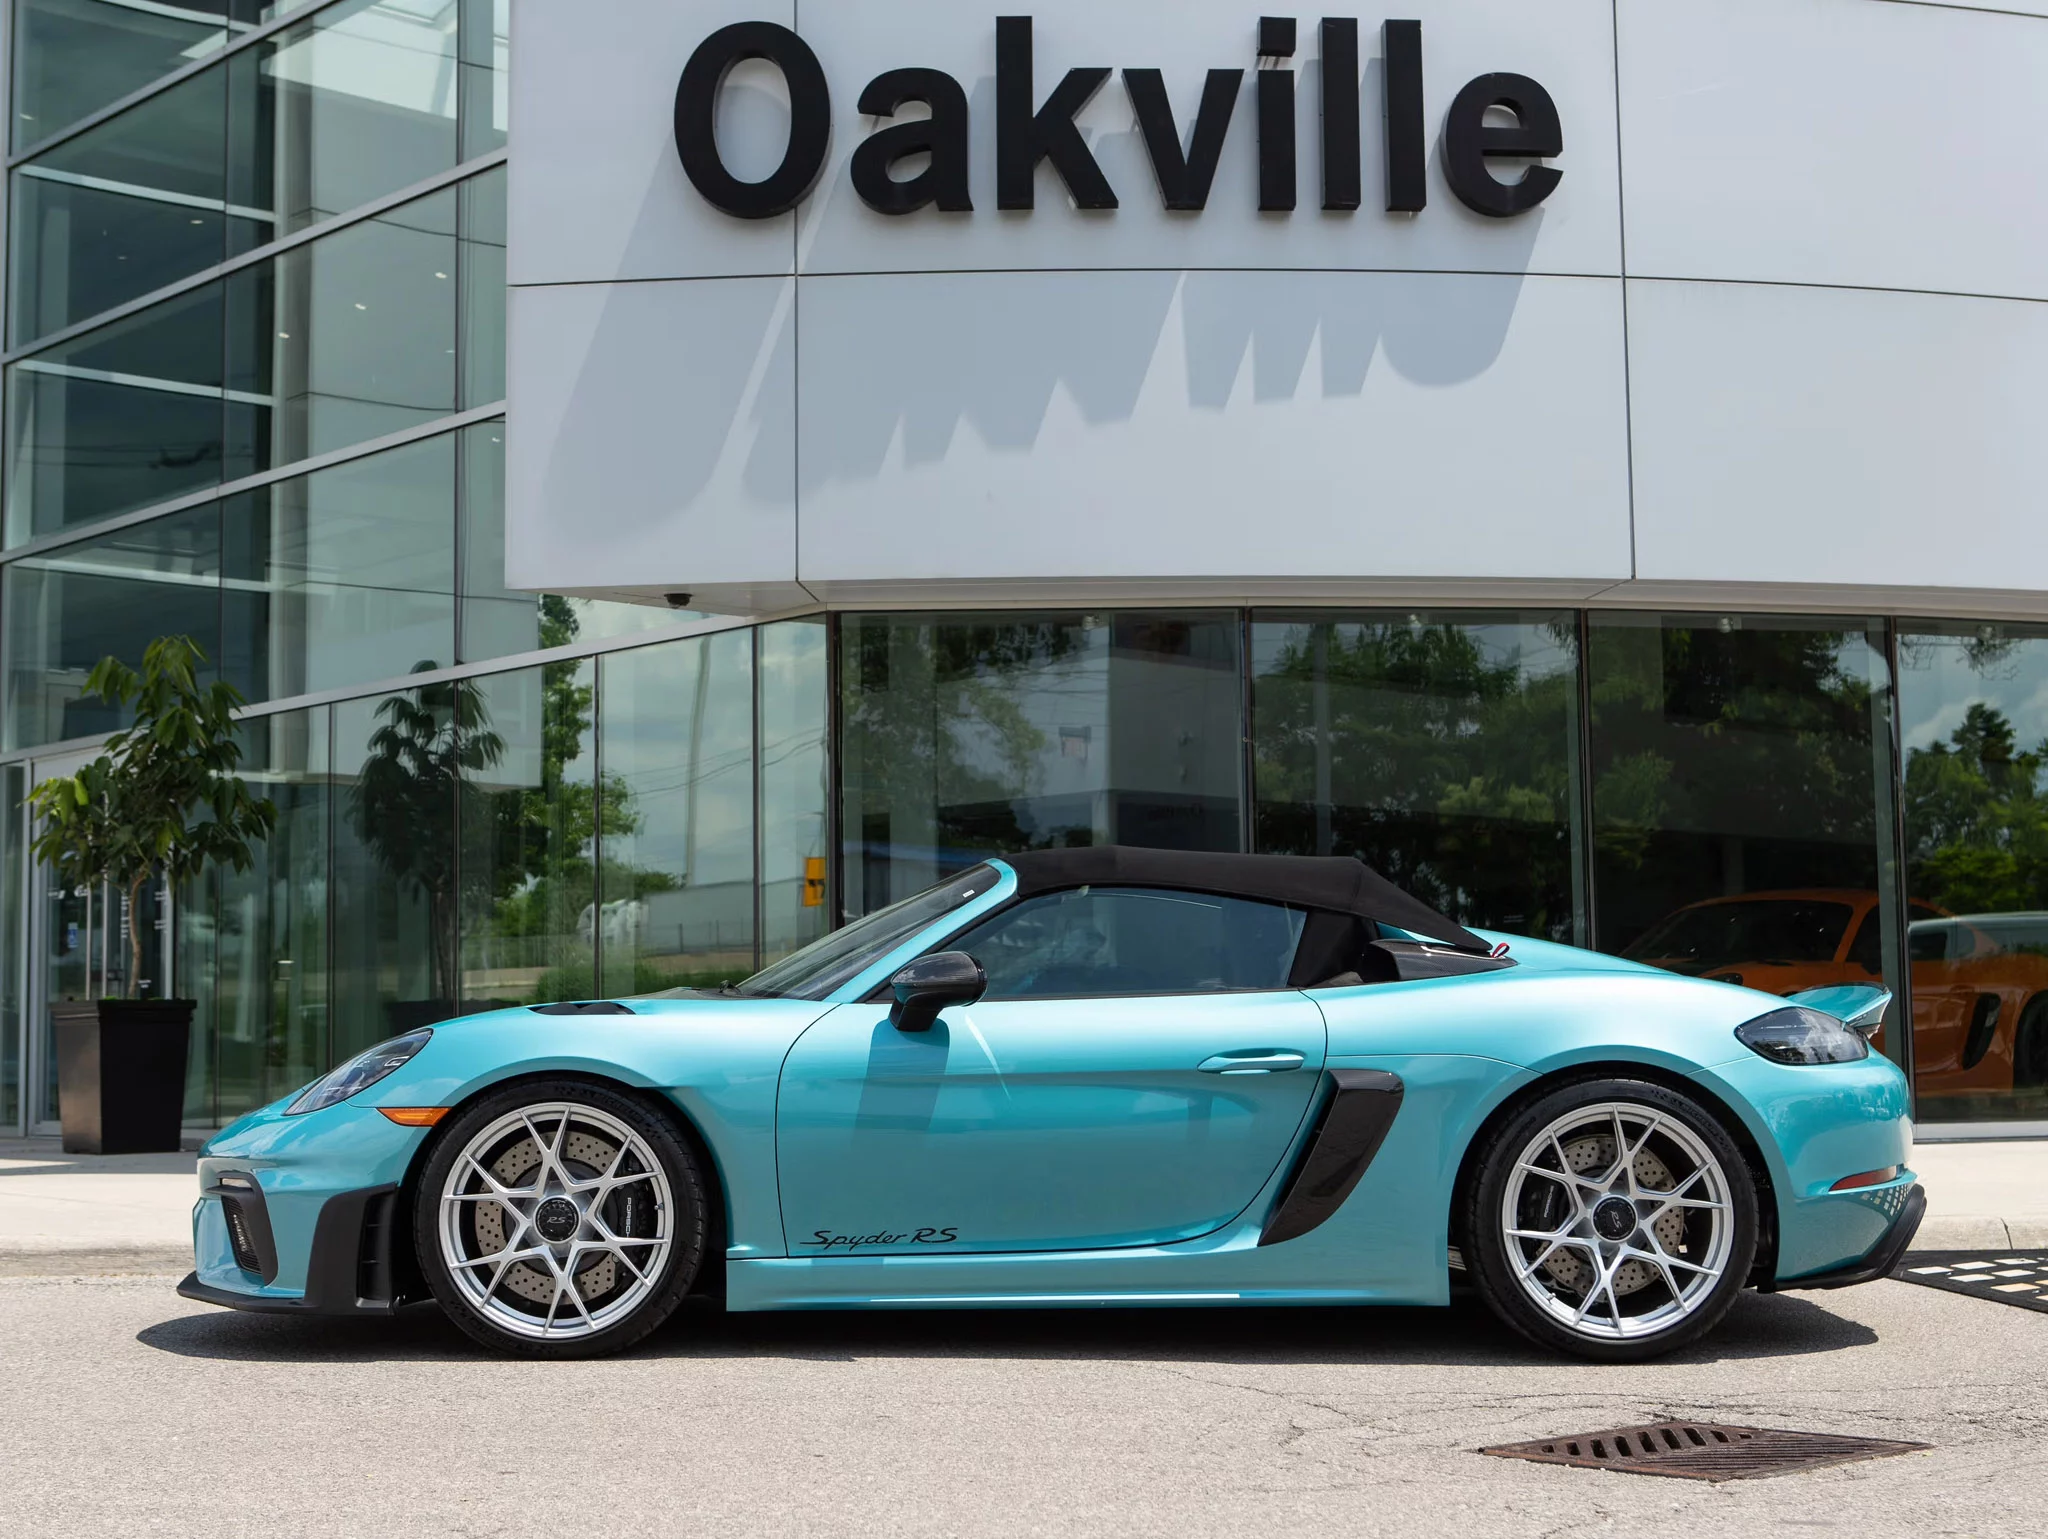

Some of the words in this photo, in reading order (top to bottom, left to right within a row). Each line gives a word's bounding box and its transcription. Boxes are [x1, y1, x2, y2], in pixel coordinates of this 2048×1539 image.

[674, 16, 1564, 219] Oakville
[546, 1216, 566, 1224] RS
[800, 1230, 907, 1251] Spyder
[910, 1227, 958, 1243] RS
